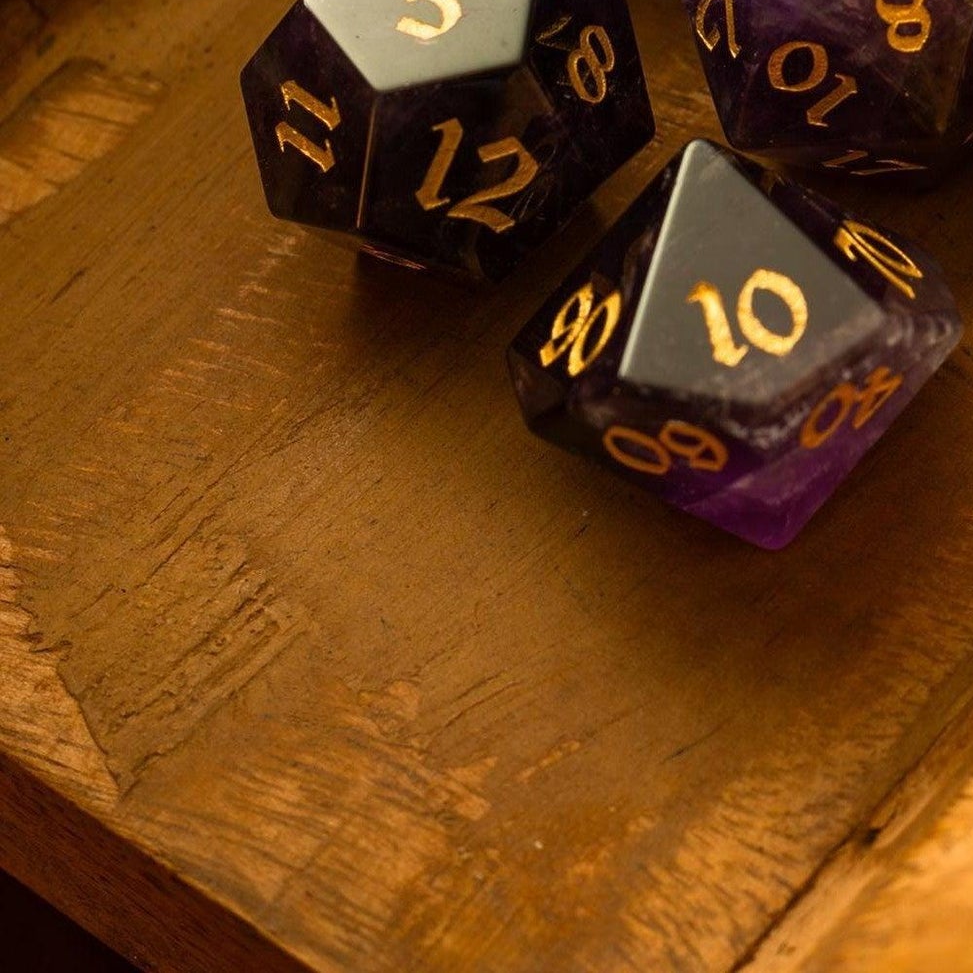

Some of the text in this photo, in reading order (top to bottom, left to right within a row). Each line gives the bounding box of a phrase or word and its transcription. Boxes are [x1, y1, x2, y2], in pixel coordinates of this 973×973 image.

[276, 79, 342, 174] 11
[415, 117, 541, 234] 12
[685, 268, 809, 368] 10
